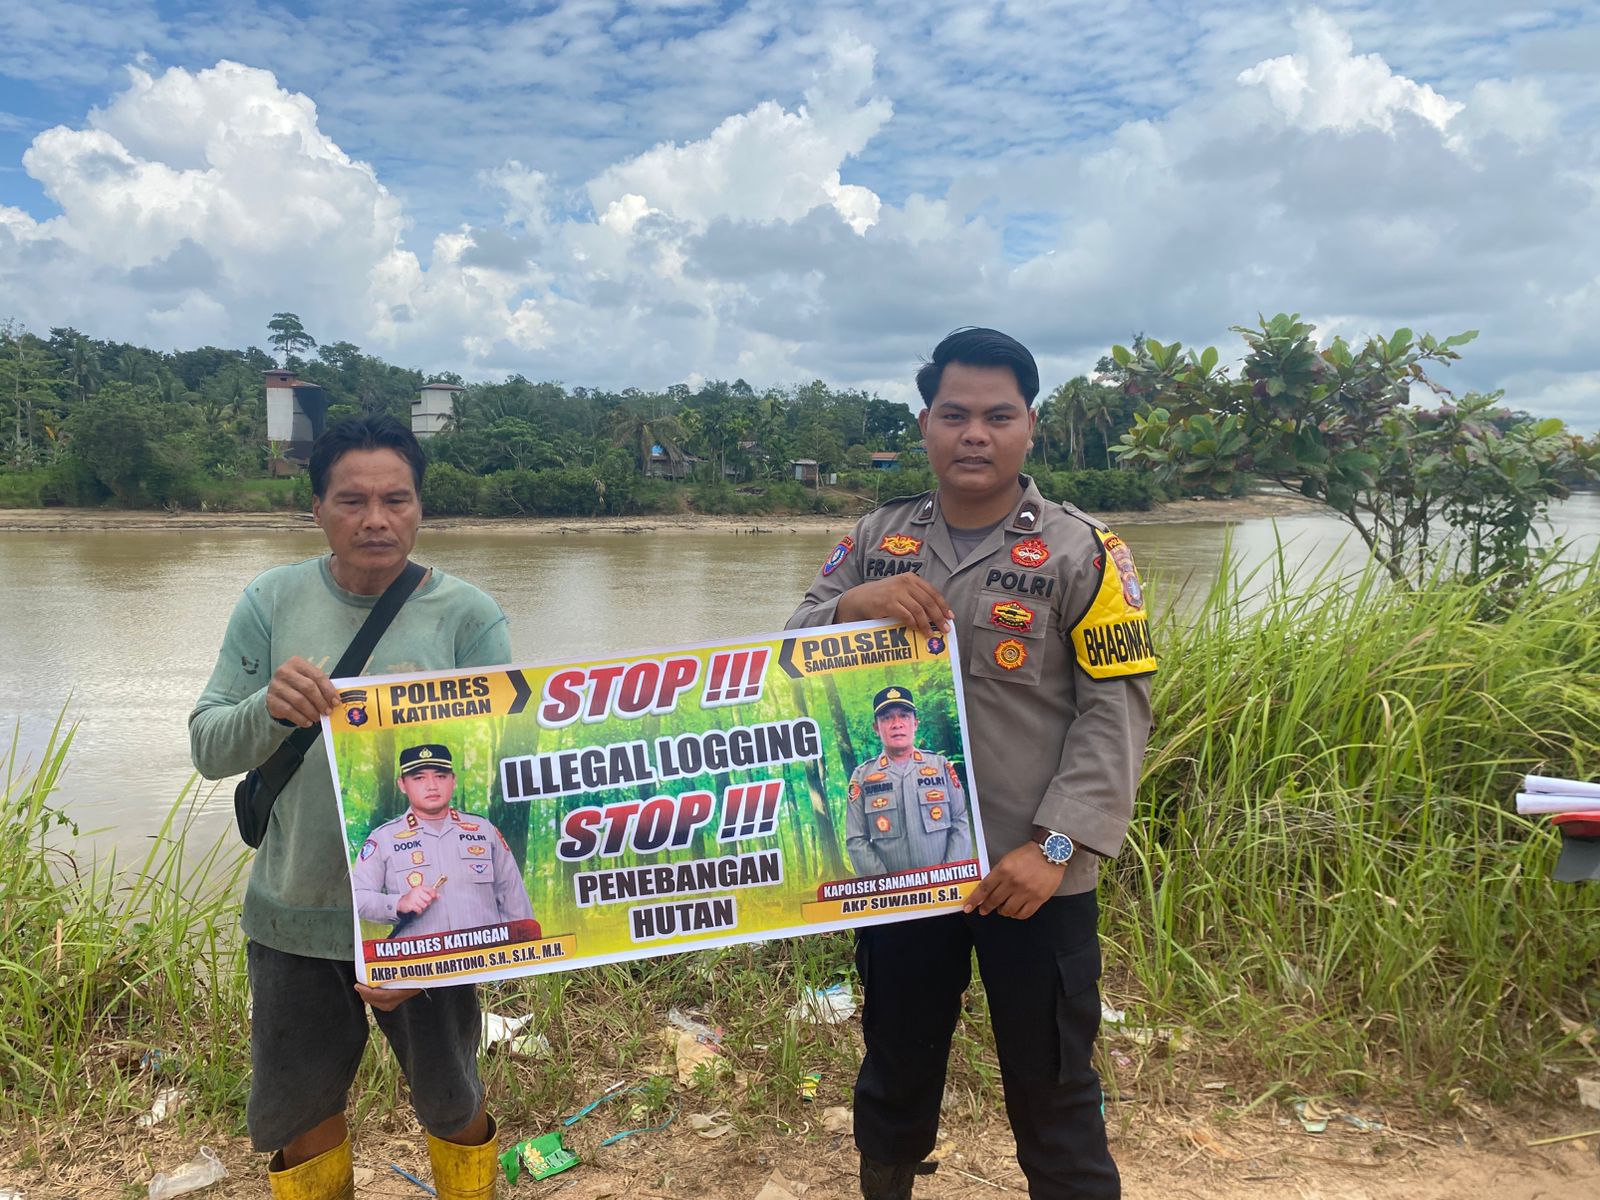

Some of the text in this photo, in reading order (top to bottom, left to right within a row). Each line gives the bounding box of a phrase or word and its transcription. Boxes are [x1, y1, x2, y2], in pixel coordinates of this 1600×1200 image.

[866, 558, 922, 576] FRANZ
[985, 568, 1055, 598] POLRI
[801, 626, 911, 661] POLSEK
[804, 647, 913, 673] SANAMAN MANTIKEI
[389, 676, 490, 707] POLRES
[542, 649, 769, 724] STOP !!!
[392, 699, 492, 725] KATINGAN
[504, 720, 819, 798] ILLEGAL LOGGING
[917, 776, 945, 787] POLRI
[559, 781, 782, 860] STOP !!!
[393, 840, 422, 852] DODIK
[459, 833, 487, 842] POLRI
[577, 852, 780, 904] PENEBANGAN
[823, 863, 978, 898] KAPOLSEK SANAMAN MANTIKEI
[842, 887, 962, 913] AKP SUWARDI, S.H.
[632, 899, 734, 939] HUTAN
[375, 926, 509, 958] KAPOLRES KATINGAN
[371, 965, 398, 981] AKBP
[400, 962, 433, 978] DODIK
[435, 953, 488, 975] HARTONO,
[541, 942, 565, 958] M.H.
